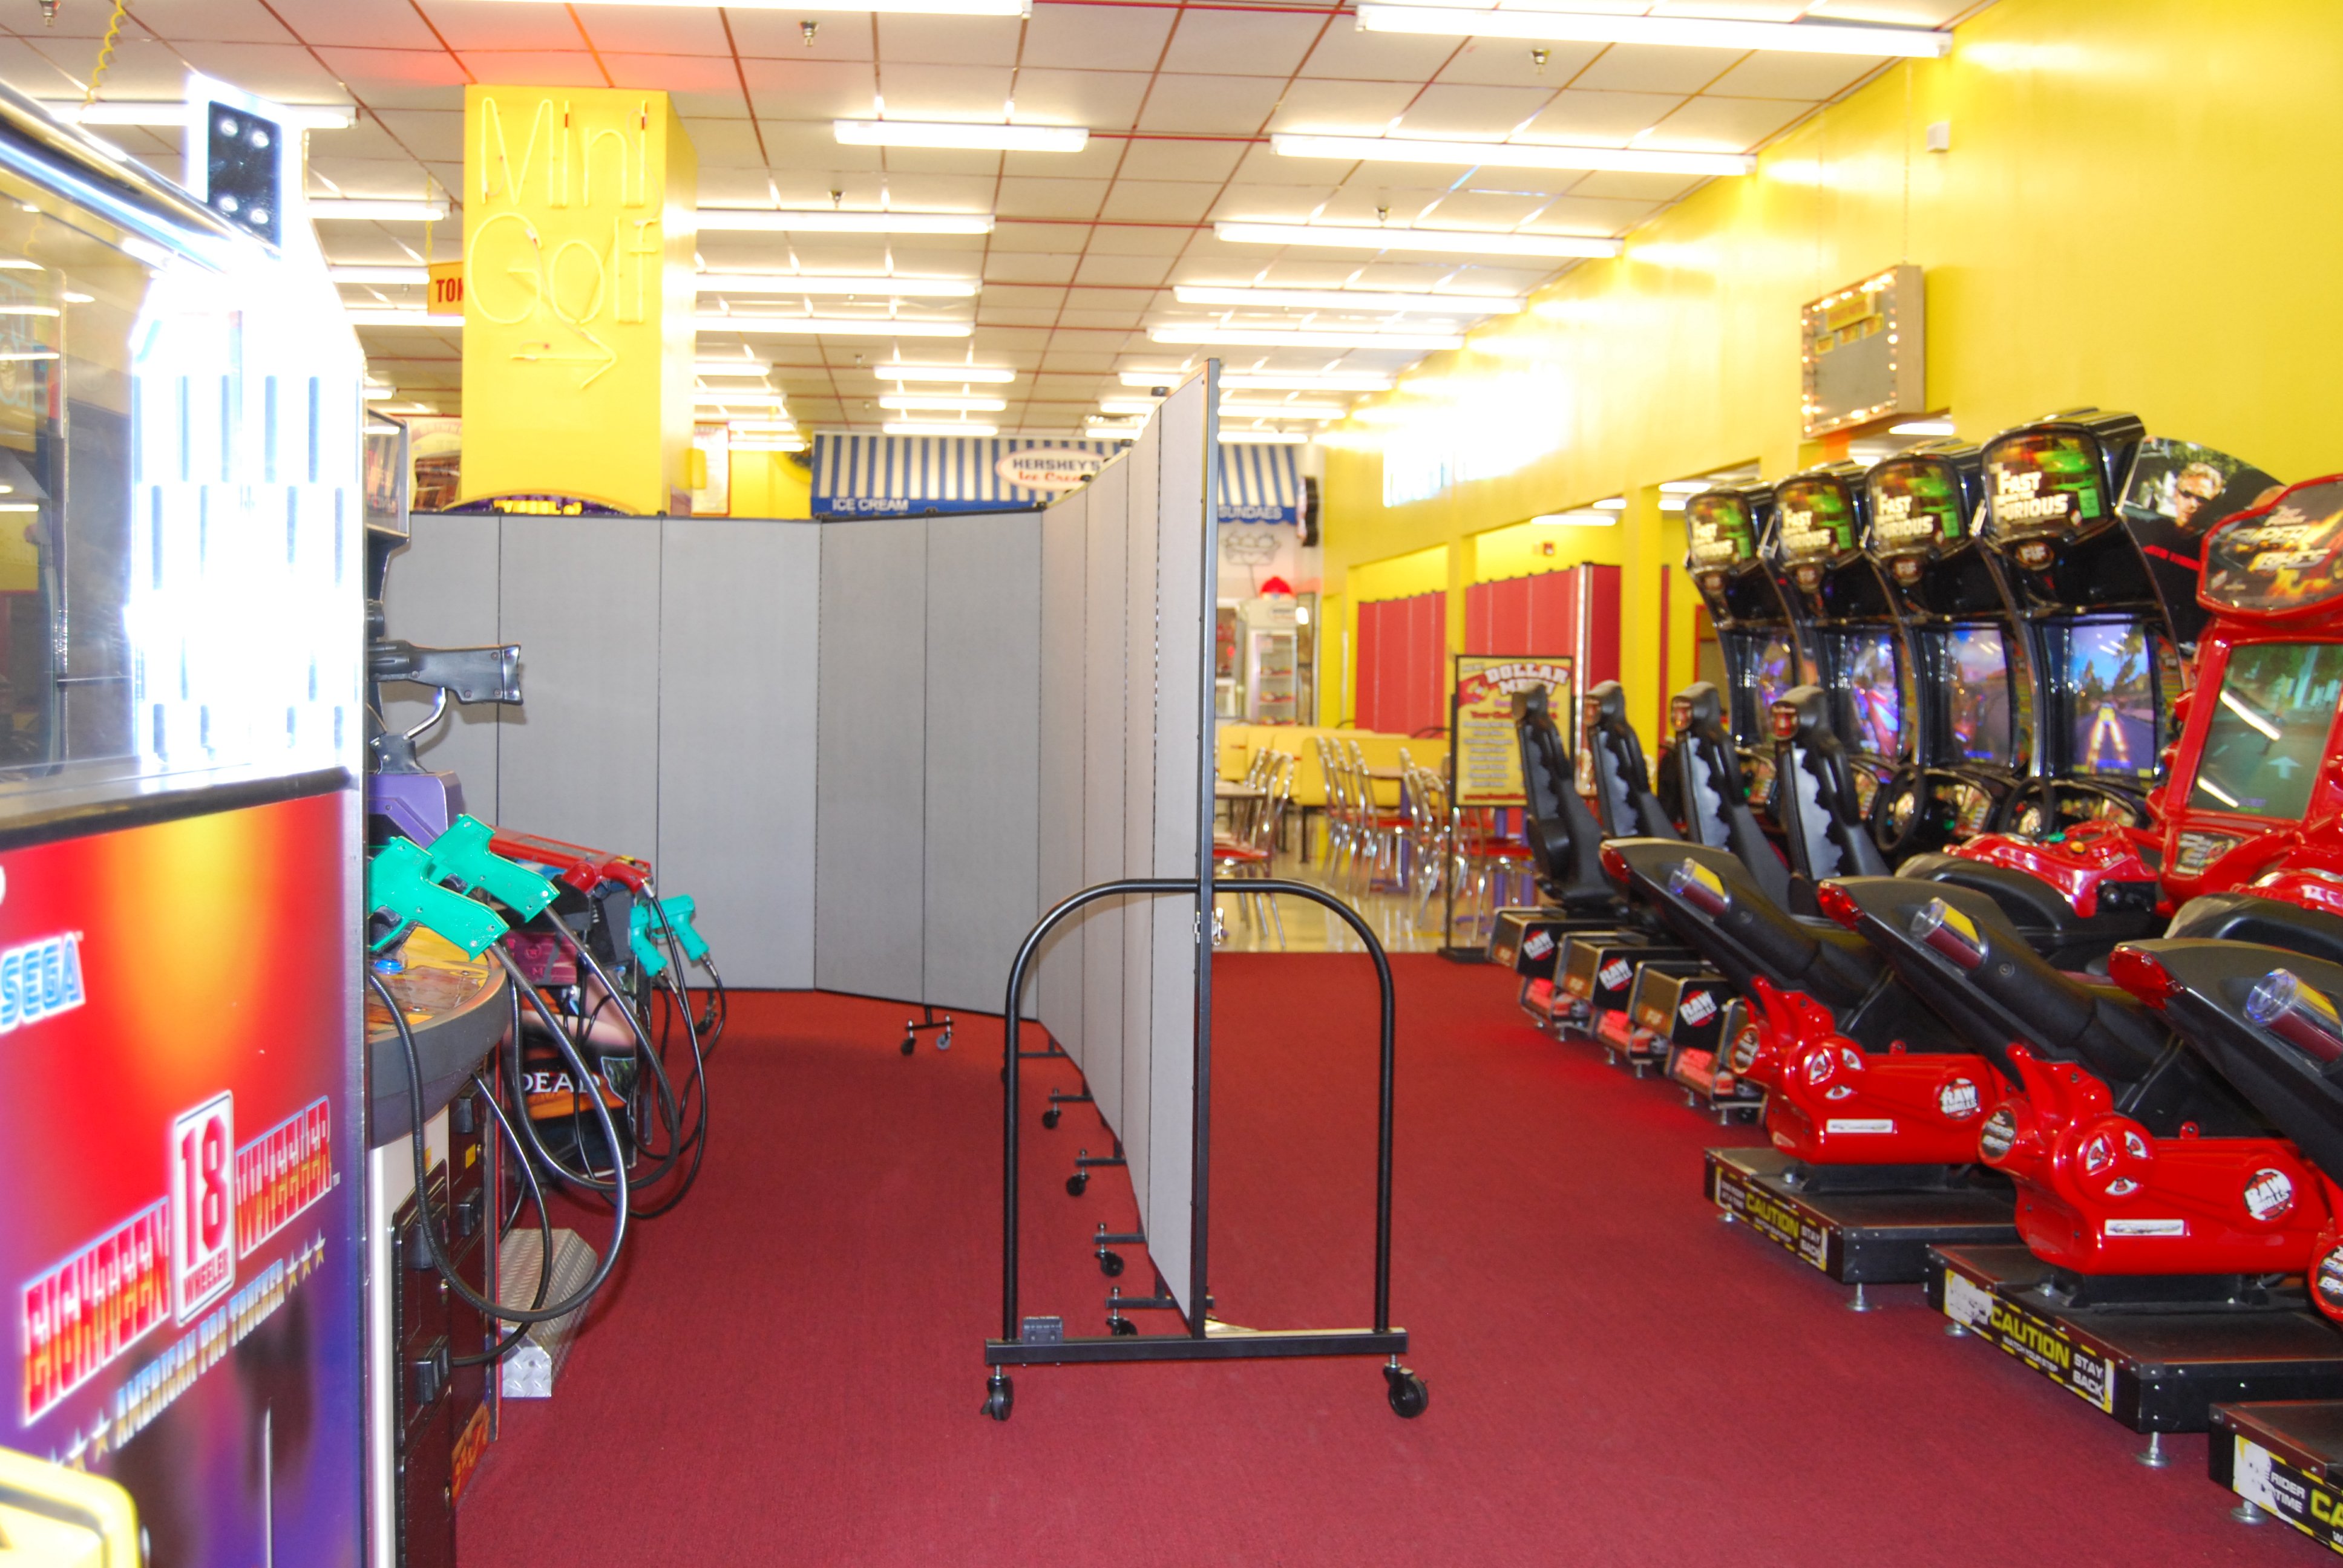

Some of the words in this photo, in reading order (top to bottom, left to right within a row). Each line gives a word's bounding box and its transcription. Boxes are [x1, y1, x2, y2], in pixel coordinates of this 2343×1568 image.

[482, 97, 647, 206] Mini
[467, 212, 658, 324] Golf
[1998, 470, 2042, 494] FAST
[832, 498, 856, 511] ICE
[857, 498, 909, 512] CREAM
[1878, 494, 1913, 515] FAST
[1992, 493, 2068, 525] FURIOUS
[1875, 515, 1934, 538] FURIOUS
[1484, 662, 1569, 685] DOLLAR
[1524, 931, 1552, 952] RAW
[0, 935, 82, 1028] SEGA
[1599, 959, 1629, 983] RAW
[1680, 991, 1714, 1017] RAW
[1940, 1085, 1976, 1106] RAW
[182, 1114, 229, 1270] 18
[2244, 1174, 2292, 1207] RAW
[1746, 1192, 1800, 1239] CAUTION
[184, 1250, 229, 1311] WHEELER
[1990, 1305, 2070, 1370] CAUTION
[116, 1328, 198, 1450] AMERICAN
[199, 1305, 228, 1376] PRO
[229, 1258, 286, 1348] TRUCKER
[2074, 1352, 2104, 1379] STAY
[2073, 1369, 2105, 1400] BACK
[2270, 1471, 2305, 1500] RIDER
